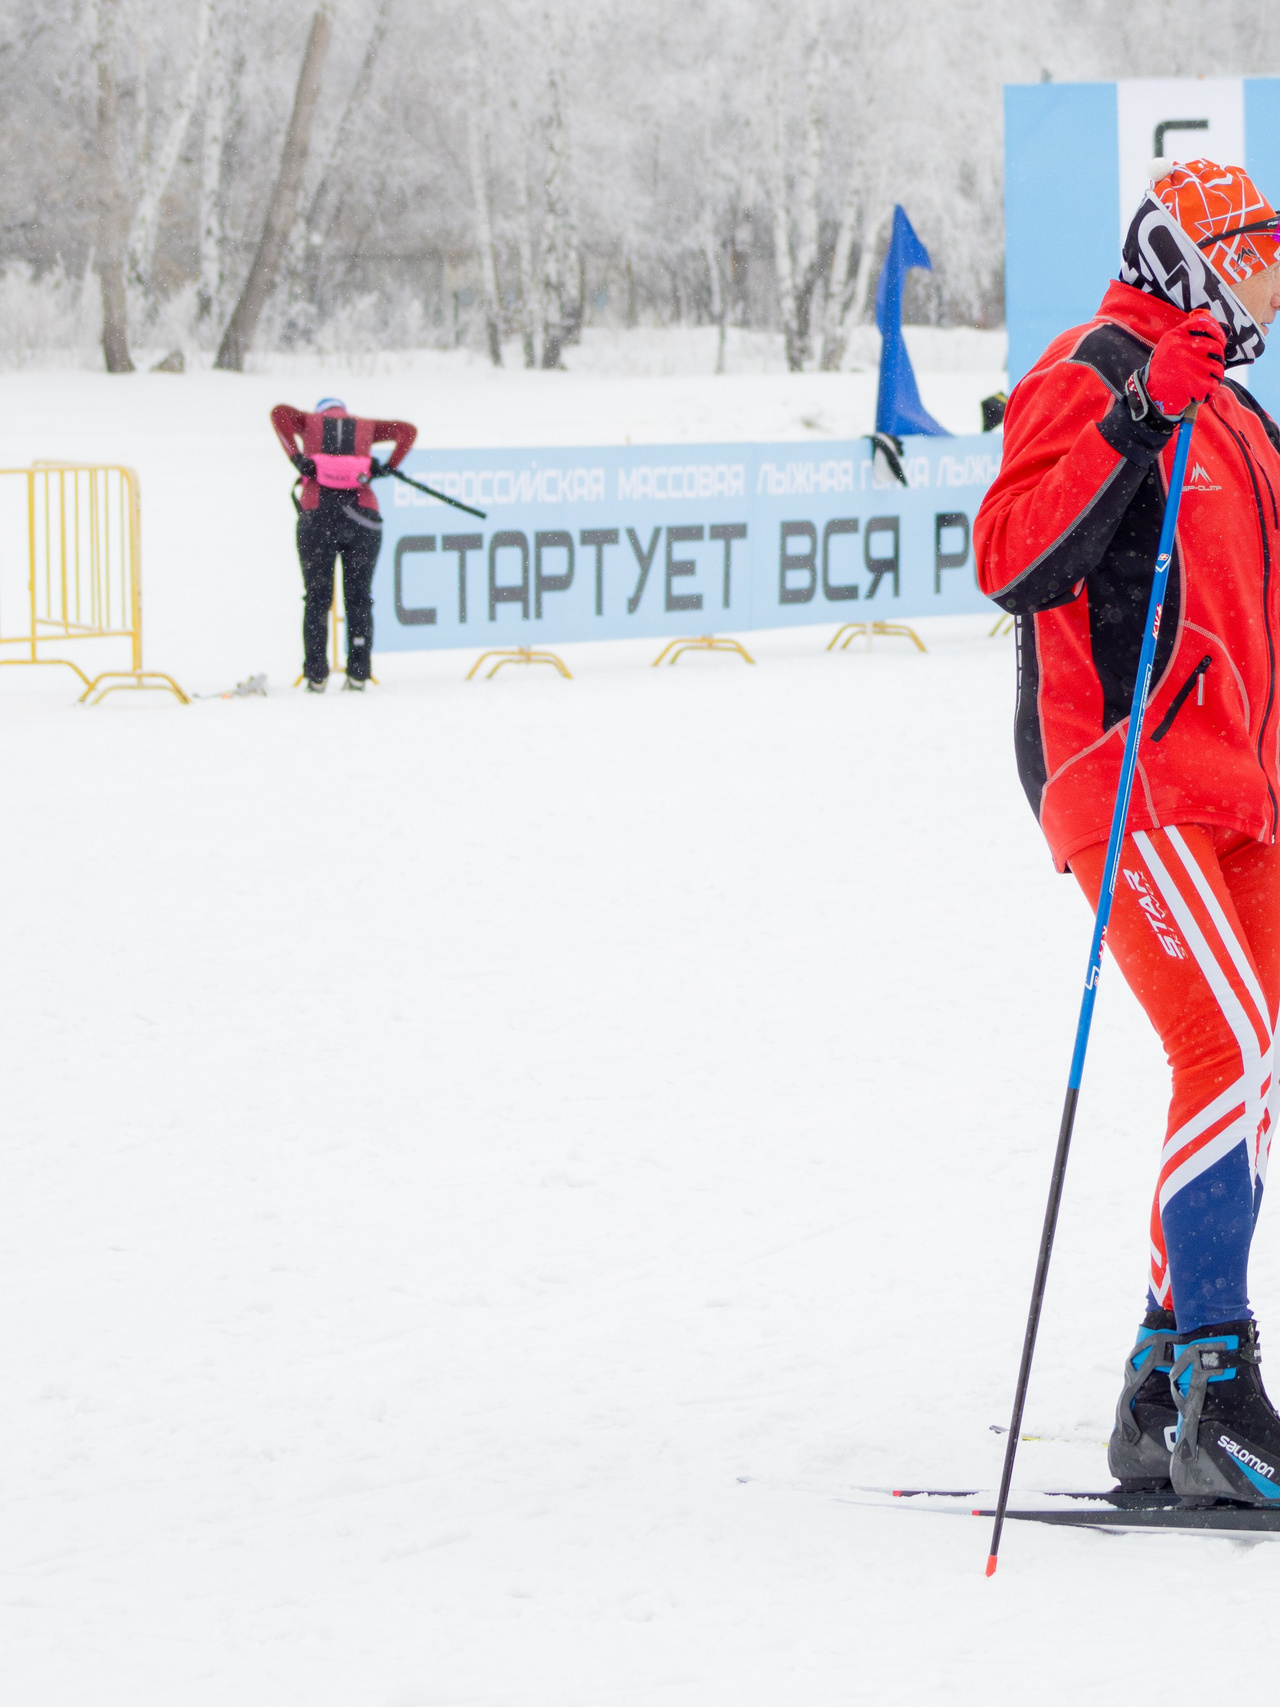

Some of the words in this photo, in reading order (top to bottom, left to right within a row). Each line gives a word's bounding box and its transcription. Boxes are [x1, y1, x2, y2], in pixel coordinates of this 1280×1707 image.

[393, 461, 606, 507] ВСЕРОССИЙСКАЯ
[618, 463, 746, 501] МАССОВАЯ
[756, 460, 854, 497] ЛЫЖНАЯ
[936, 453, 1003, 487] ЛЫЖН
[394, 523, 748, 626] СТАРТУЕТ
[778, 515, 901, 606] ВСЯ
[1123, 868, 1184, 960] STAR
